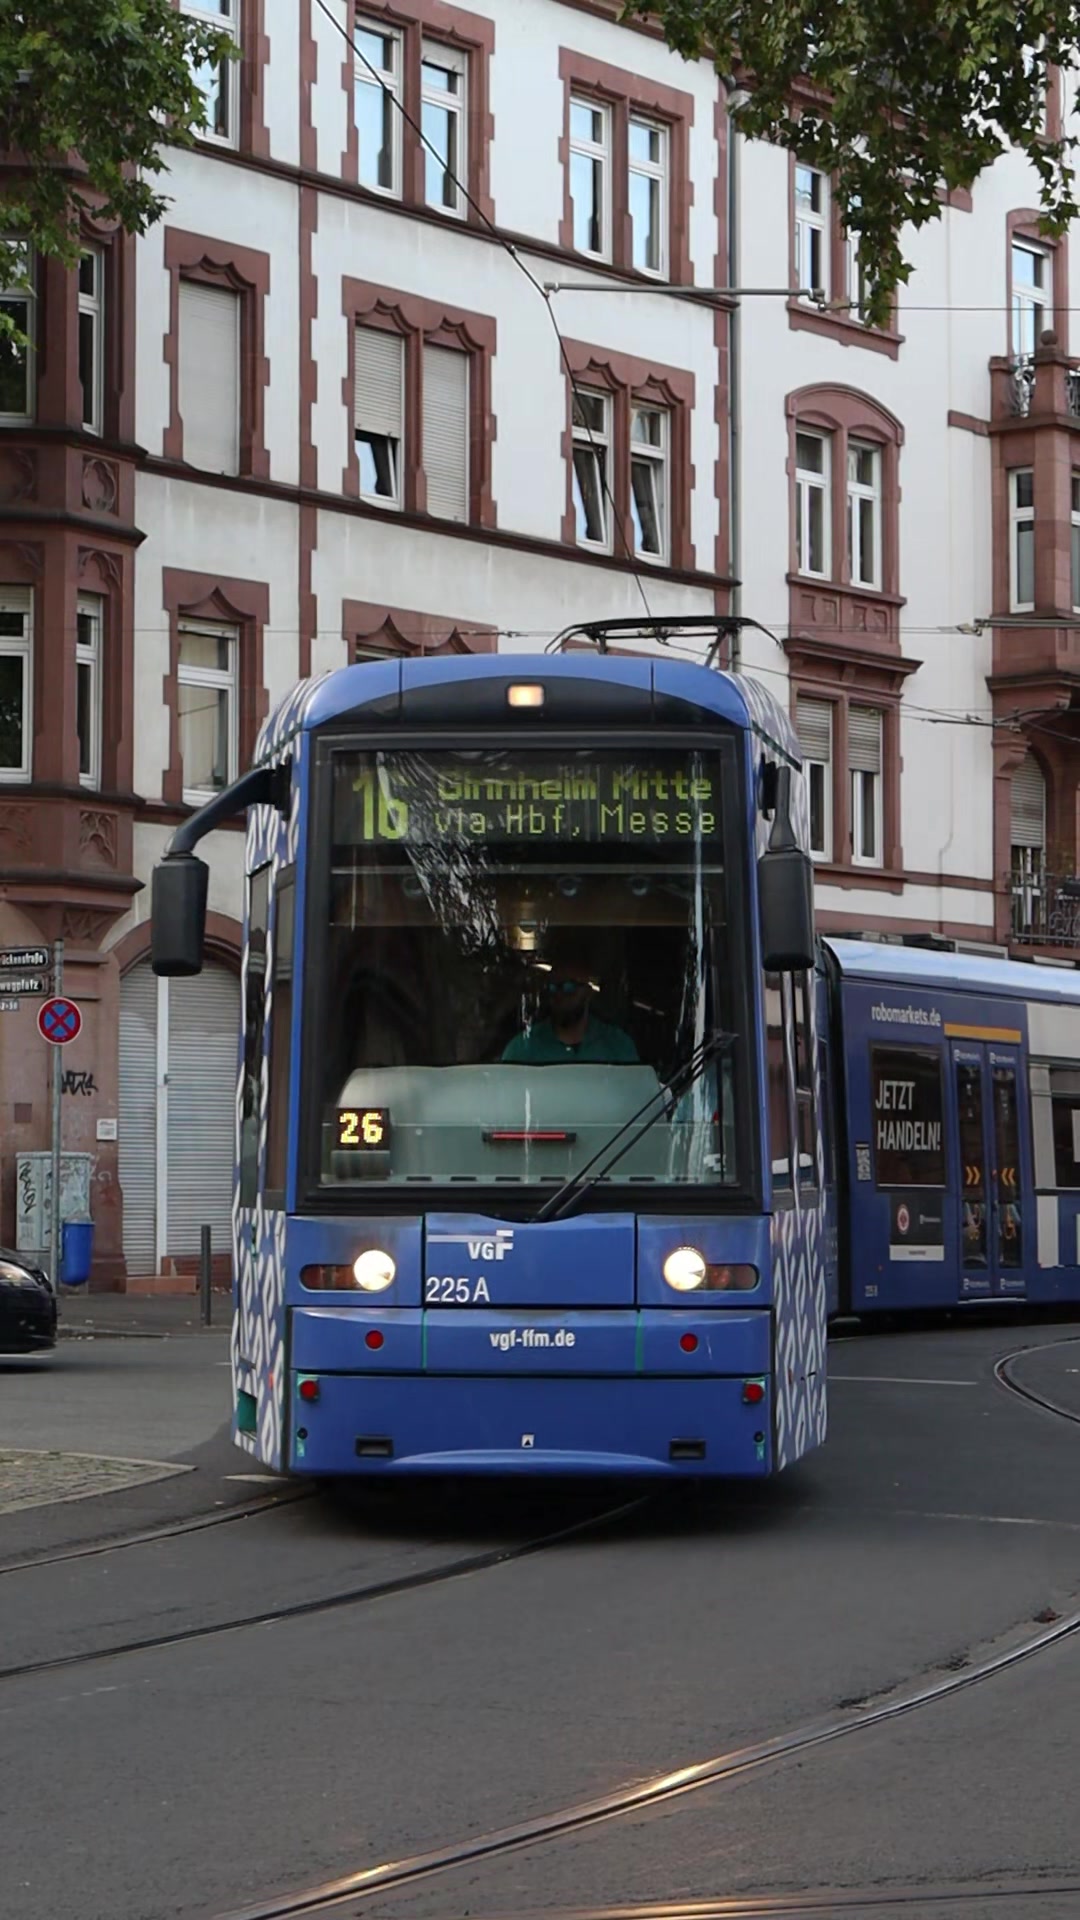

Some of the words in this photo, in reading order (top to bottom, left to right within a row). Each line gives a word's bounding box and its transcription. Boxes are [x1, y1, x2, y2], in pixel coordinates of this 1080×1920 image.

[438, 772, 596, 800] Ginnheim
[613, 771, 712, 799] Mitte
[353, 772, 408, 839] 16
[435, 808, 486, 833] via
[506, 804, 580, 836] Hbf,
[601, 804, 715, 833] Messe
[871, 1003, 941, 1026] robomarkets.de
[875, 1080, 915, 1109] JETZT
[339, 1112, 383, 1144] 26
[877, 1121, 941, 1150] HANDELN!
[467, 1230, 514, 1260] VGF
[489, 1329, 575, 1351] vgf-ffm.de
